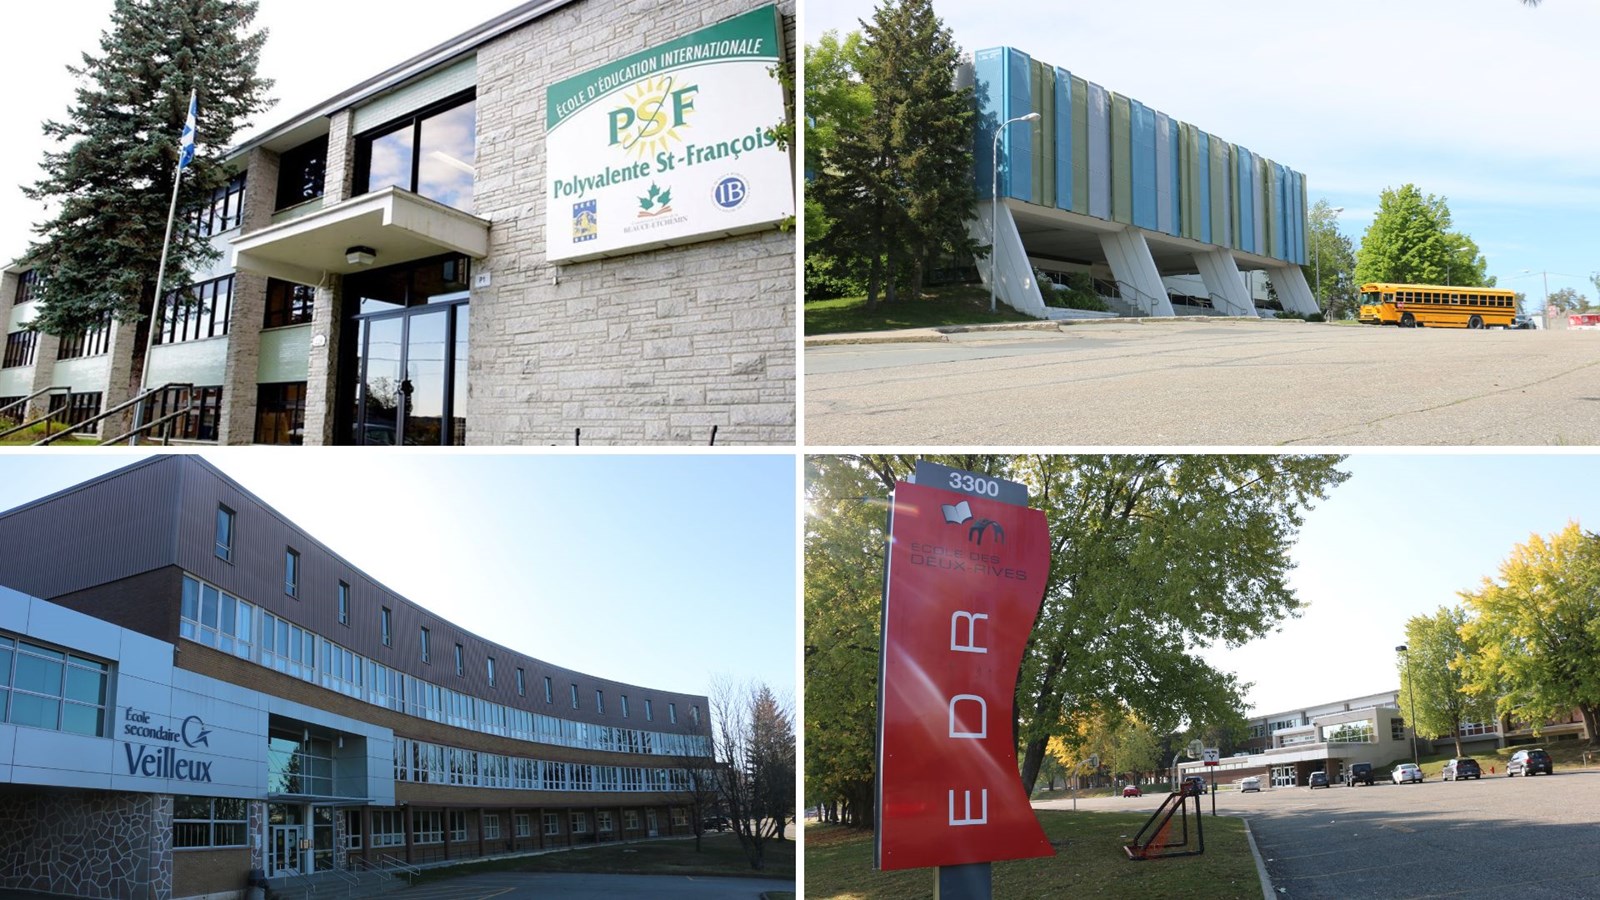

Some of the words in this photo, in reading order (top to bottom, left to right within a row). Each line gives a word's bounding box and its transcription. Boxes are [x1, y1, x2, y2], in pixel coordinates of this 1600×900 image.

[556, 91, 586, 119] ÉCOLE
[587, 58, 657, 97] D'ÉDUCATION
[661, 38, 763, 67] INTERNATIONALE
[608, 85, 699, 147] PSF
[553, 161, 651, 199] Polyvalente
[657, 126, 777, 173] St-François
[719, 181, 744, 204] IB
[949, 472, 999, 497] 3300
[970, 552, 1001, 564] DES
[125, 706, 151, 724] École
[124, 724, 181, 742] secondaire
[124, 742, 213, 782] Veilleux
